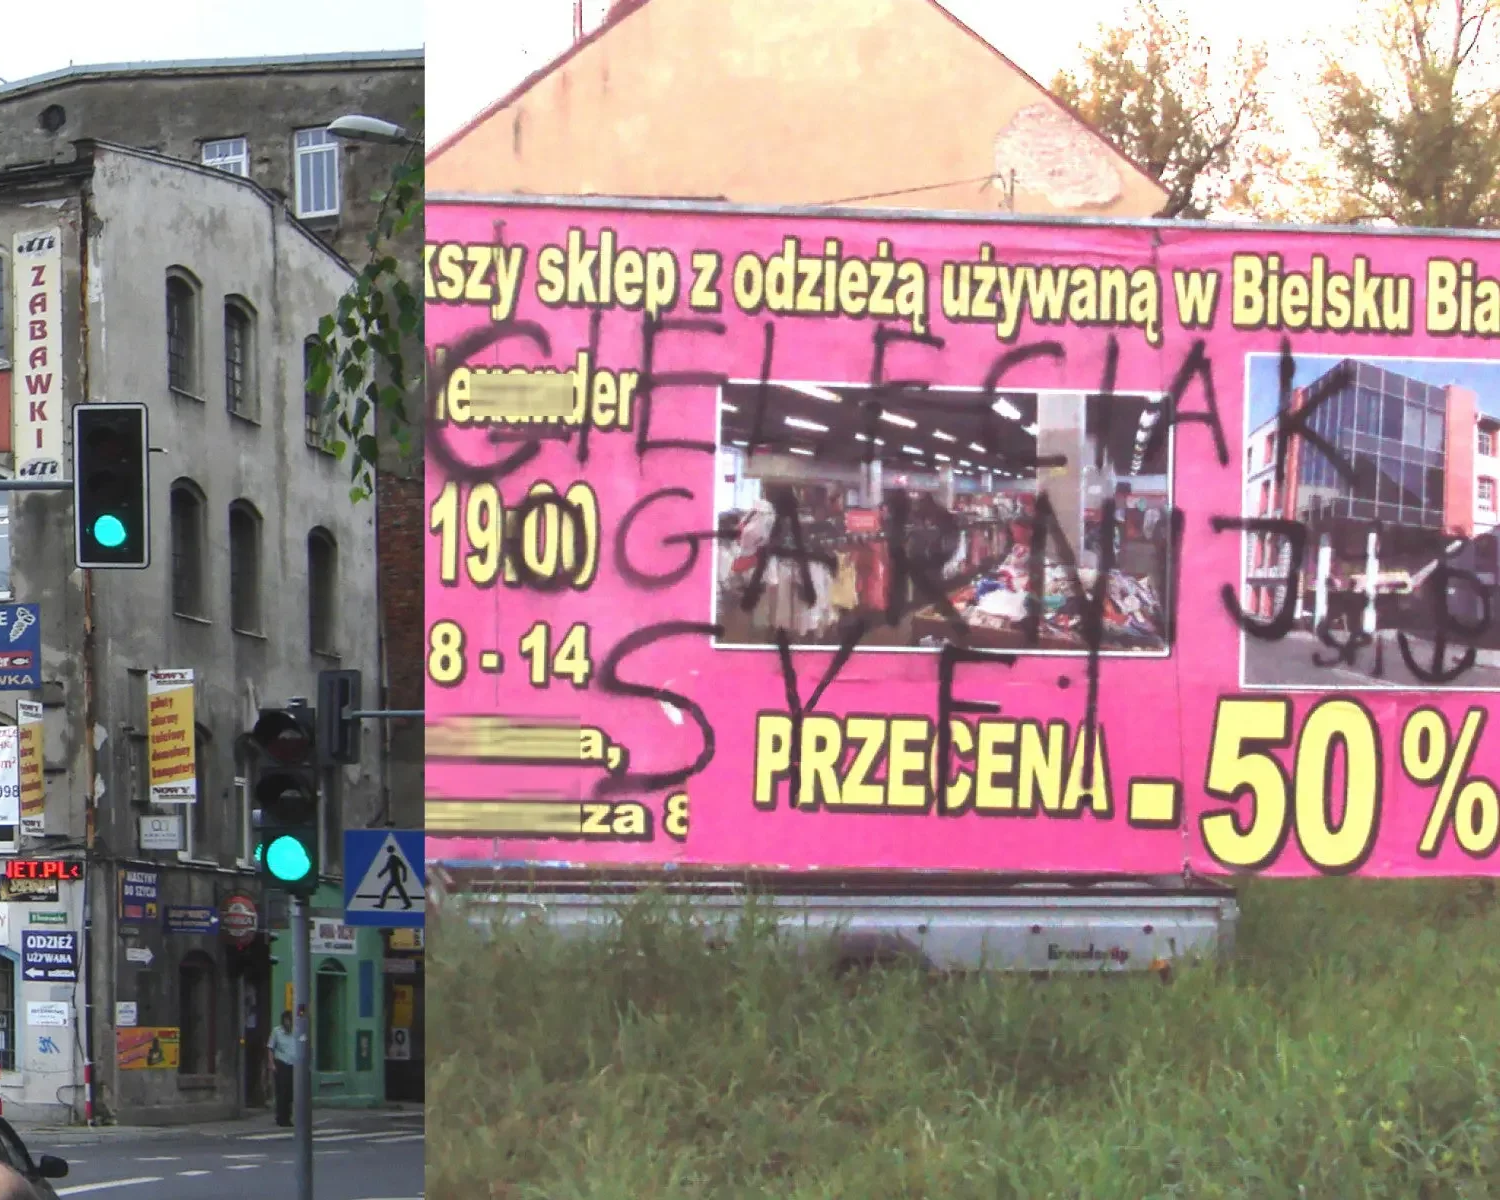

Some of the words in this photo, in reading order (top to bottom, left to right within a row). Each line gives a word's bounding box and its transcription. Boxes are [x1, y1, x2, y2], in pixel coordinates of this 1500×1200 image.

[535, 227, 680, 322] sklep
[688, 249, 723, 311] z
[732, 235, 928, 334] odzieżą
[941, 245, 1163, 346] używaną
[1173, 269, 1217, 330] w
[1231, 251, 1412, 334] Bielsku
[25, 265, 53, 449] ZABAWKI
[428, 619, 467, 689] 8
[518, 620, 593, 689] 14
[753, 710, 1112, 816] PRZECENA
[26, 934, 73, 949] ODZIEŻ
[26, 953, 73, 964] UŻYWANA
